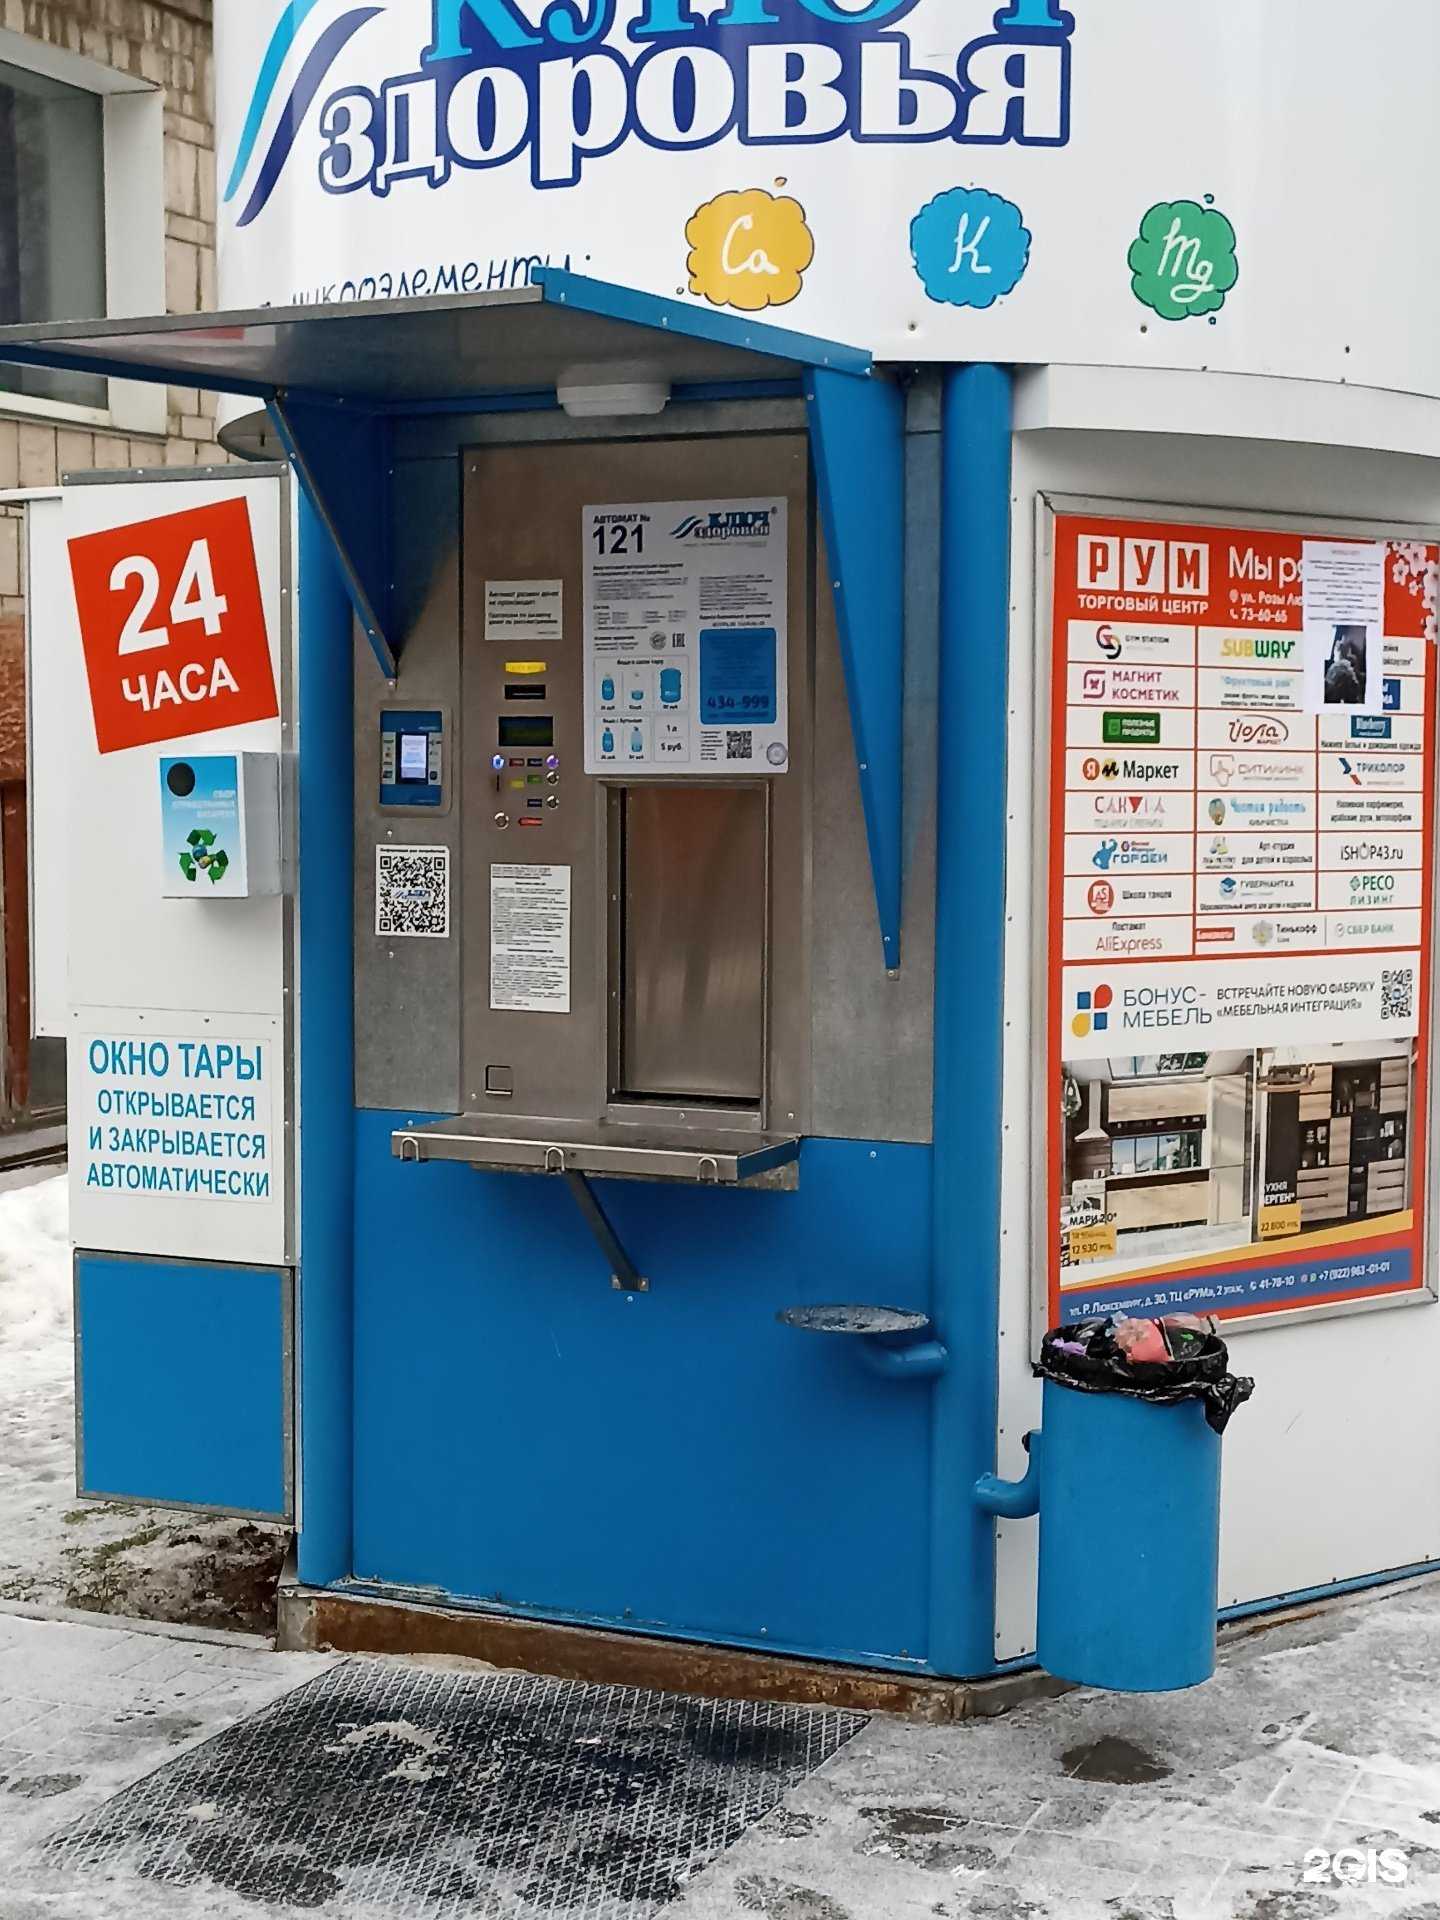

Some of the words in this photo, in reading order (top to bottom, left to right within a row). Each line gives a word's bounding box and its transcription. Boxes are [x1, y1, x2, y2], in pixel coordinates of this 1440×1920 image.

[318, 36, 1071, 194] здоровья
[721, 214, 780, 275] Ca
[948, 212, 992, 274] K
[1157, 217, 1215, 303] Mg
[593, 513, 638, 524] АВТОМАТ
[592, 523, 643, 555] 121
[1089, 541, 1201, 590] РУМ
[1229, 545, 1273, 581] Мы
[109, 538, 228, 656] 24
[1078, 594, 1160, 613] ТОРГОВЫЙ
[1162, 599, 1209, 615] ЦЕНТР
[1220, 638, 1296, 659] SUBWAY
[121, 656, 240, 712] ЧАСА
[1112, 670, 1163, 683] МАГНИТ
[1112, 688, 1180, 701] КОСМЕТИК
[1123, 760, 1180, 782] Маркет
[1356, 762, 1406, 774] ТРИКОЛОР
[1340, 842, 1404, 861] iSHOP43.ru
[1362, 875, 1395, 891] РЕСО
[1349, 895, 1394, 906] ЛИЗИНГ
[1276, 923, 1318, 935] Тинькофф
[1095, 935, 1164, 955] AliExpress
[1123, 985, 1207, 1007] БОНУС-
[1216, 984, 1285, 1000] ВСТРЕЧАЙТЕ
[1287, 983, 1327, 997] НОВУЮ
[1329, 981, 1376, 995] ФАБРИКУ
[1122, 1008, 1213, 1029] МЕБЕЛЬ
[1216, 1002, 1289, 1017] «МЕБЕЛЬНАЯ
[1290, 999, 1363, 1013] ИНТЕГРАЦИЯ»
[89, 1039, 169, 1077] ОКНО
[178, 1043, 262, 1081] ТАРЫ
[98, 1089, 255, 1121] ОТКРЫВАЕТСЯ
[89, 1126, 102, 1150] И
[109, 1126, 266, 1159] ЗАКРЫВАЕТСЯ
[86, 1162, 269, 1197] АВТОМАТИЧЕСКИ
[1170, 1291, 1183, 1303] ТЦ
[1216, 1285, 1223, 1295] 2
[1318, 1270, 1329, 1281] +7
